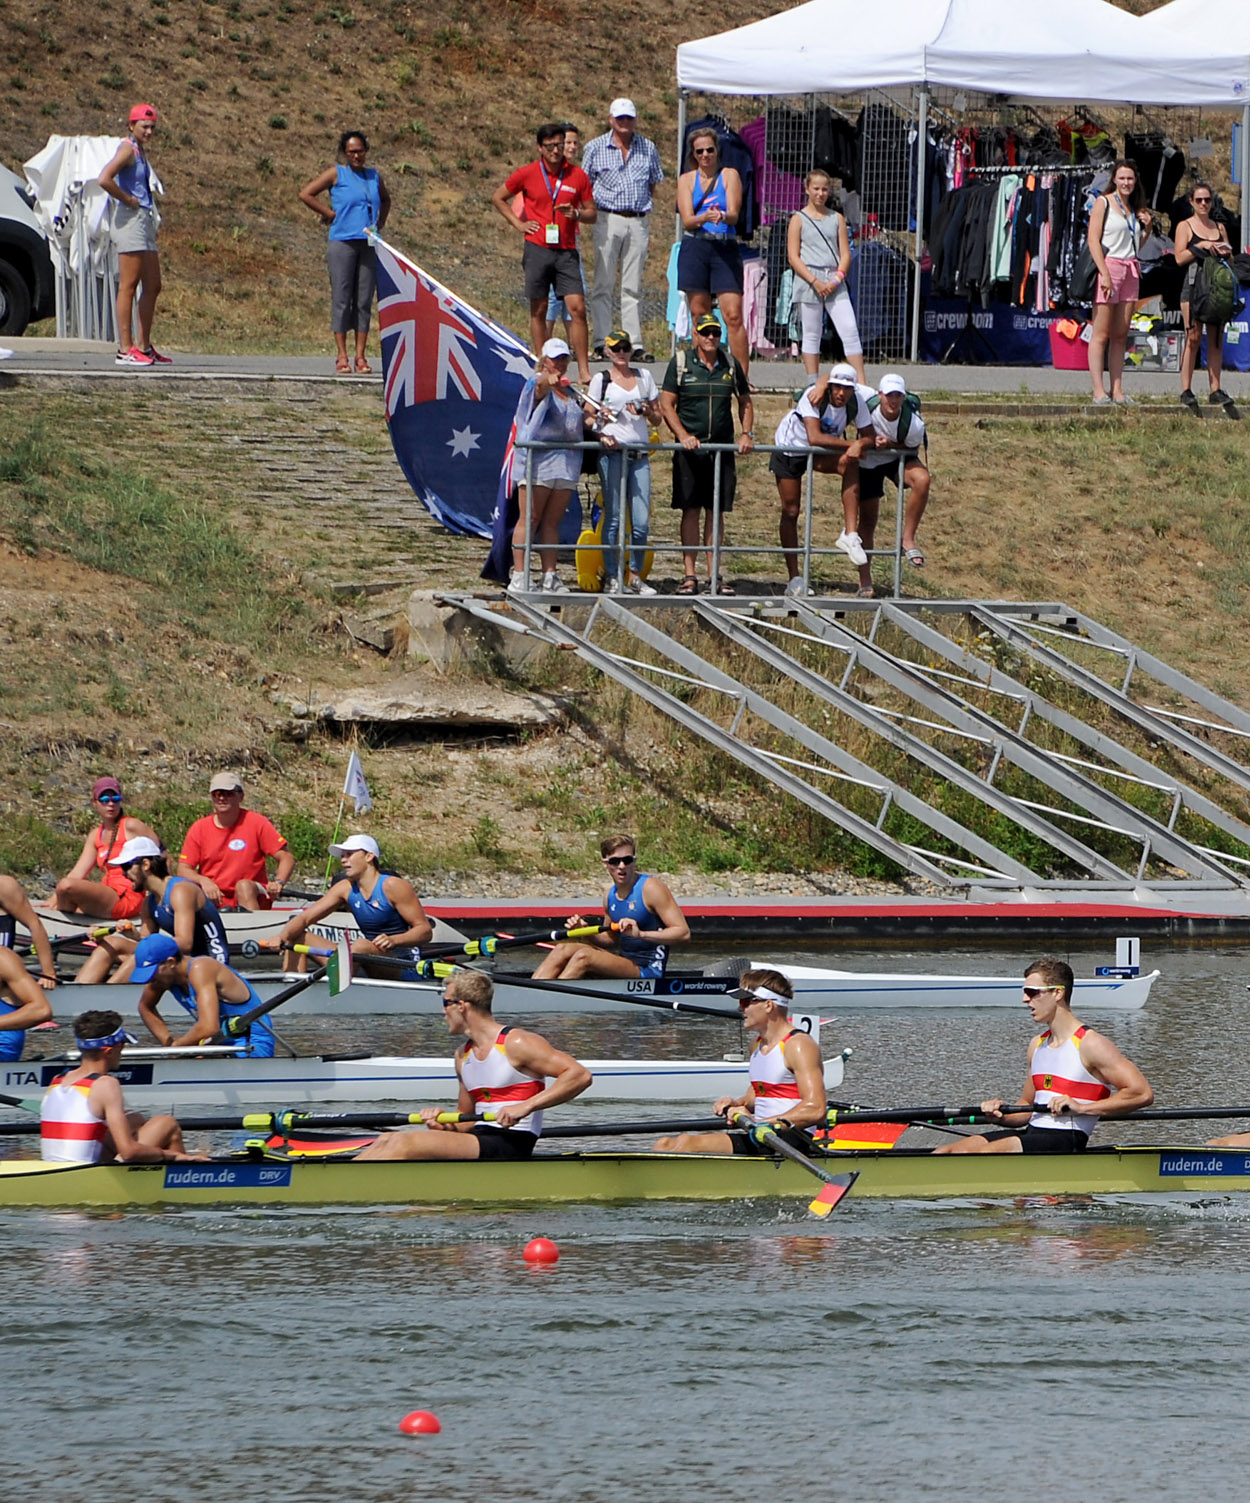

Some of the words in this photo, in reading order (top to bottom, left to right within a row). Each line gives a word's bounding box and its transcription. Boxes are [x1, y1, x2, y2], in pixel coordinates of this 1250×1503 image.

[627, 981, 652, 993] USA
[684, 982, 704, 990] world
[704, 983, 728, 992] rowing
[6, 1072, 39, 1086] ITA
[1162, 1157, 1223, 1172] rudern.de
[167, 1169, 236, 1184] rudern.de
[259, 1171, 281, 1180] DRV
